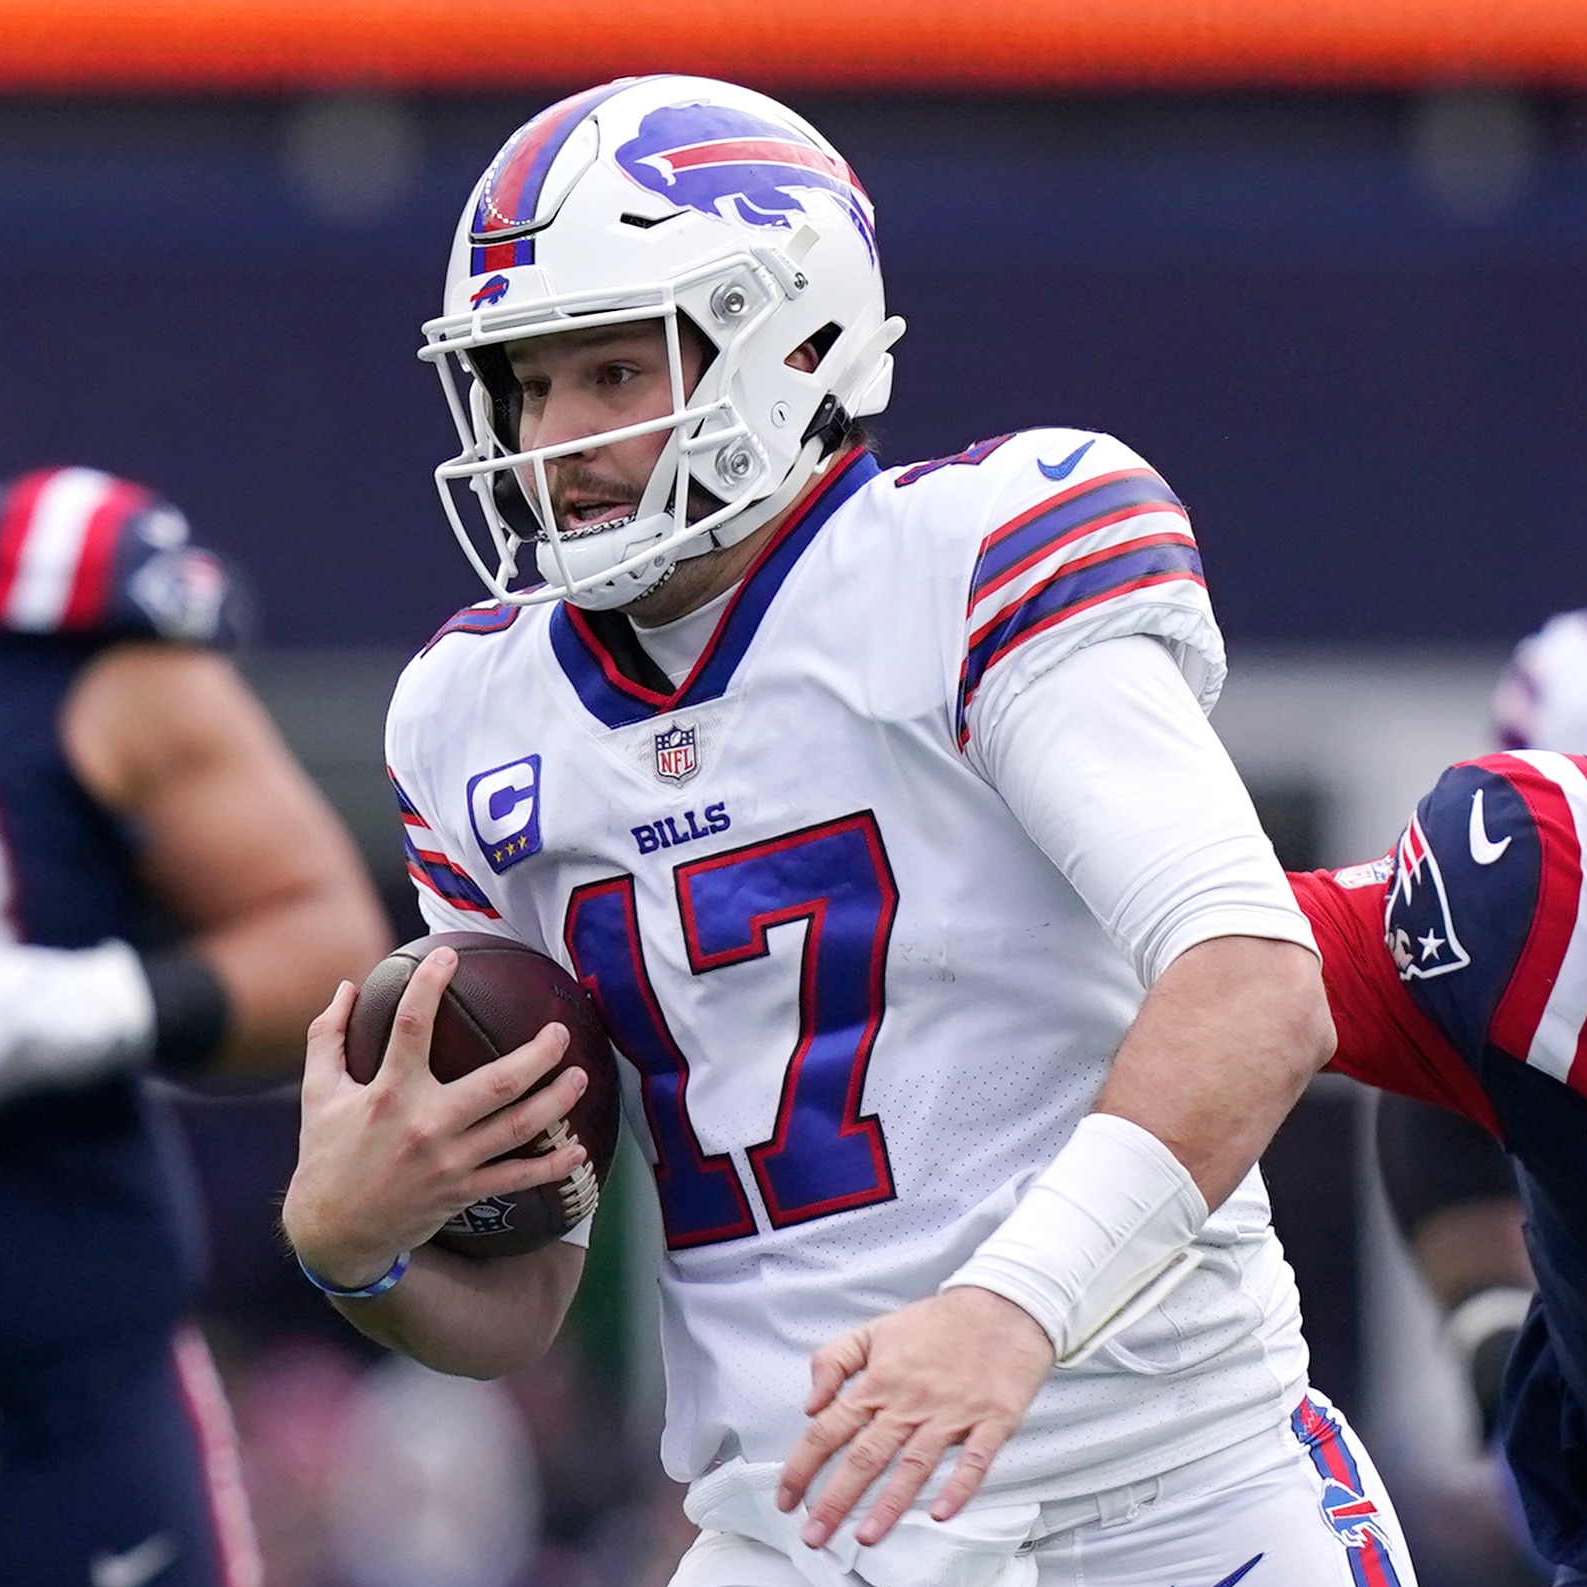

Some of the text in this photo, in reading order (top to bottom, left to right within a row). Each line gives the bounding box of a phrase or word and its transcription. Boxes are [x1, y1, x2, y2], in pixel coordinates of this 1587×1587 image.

[659, 748, 694, 775] NFL
[472, 762, 534, 845] C
[630, 801, 731, 855] BILLS
[564, 809, 899, 1250] 17
